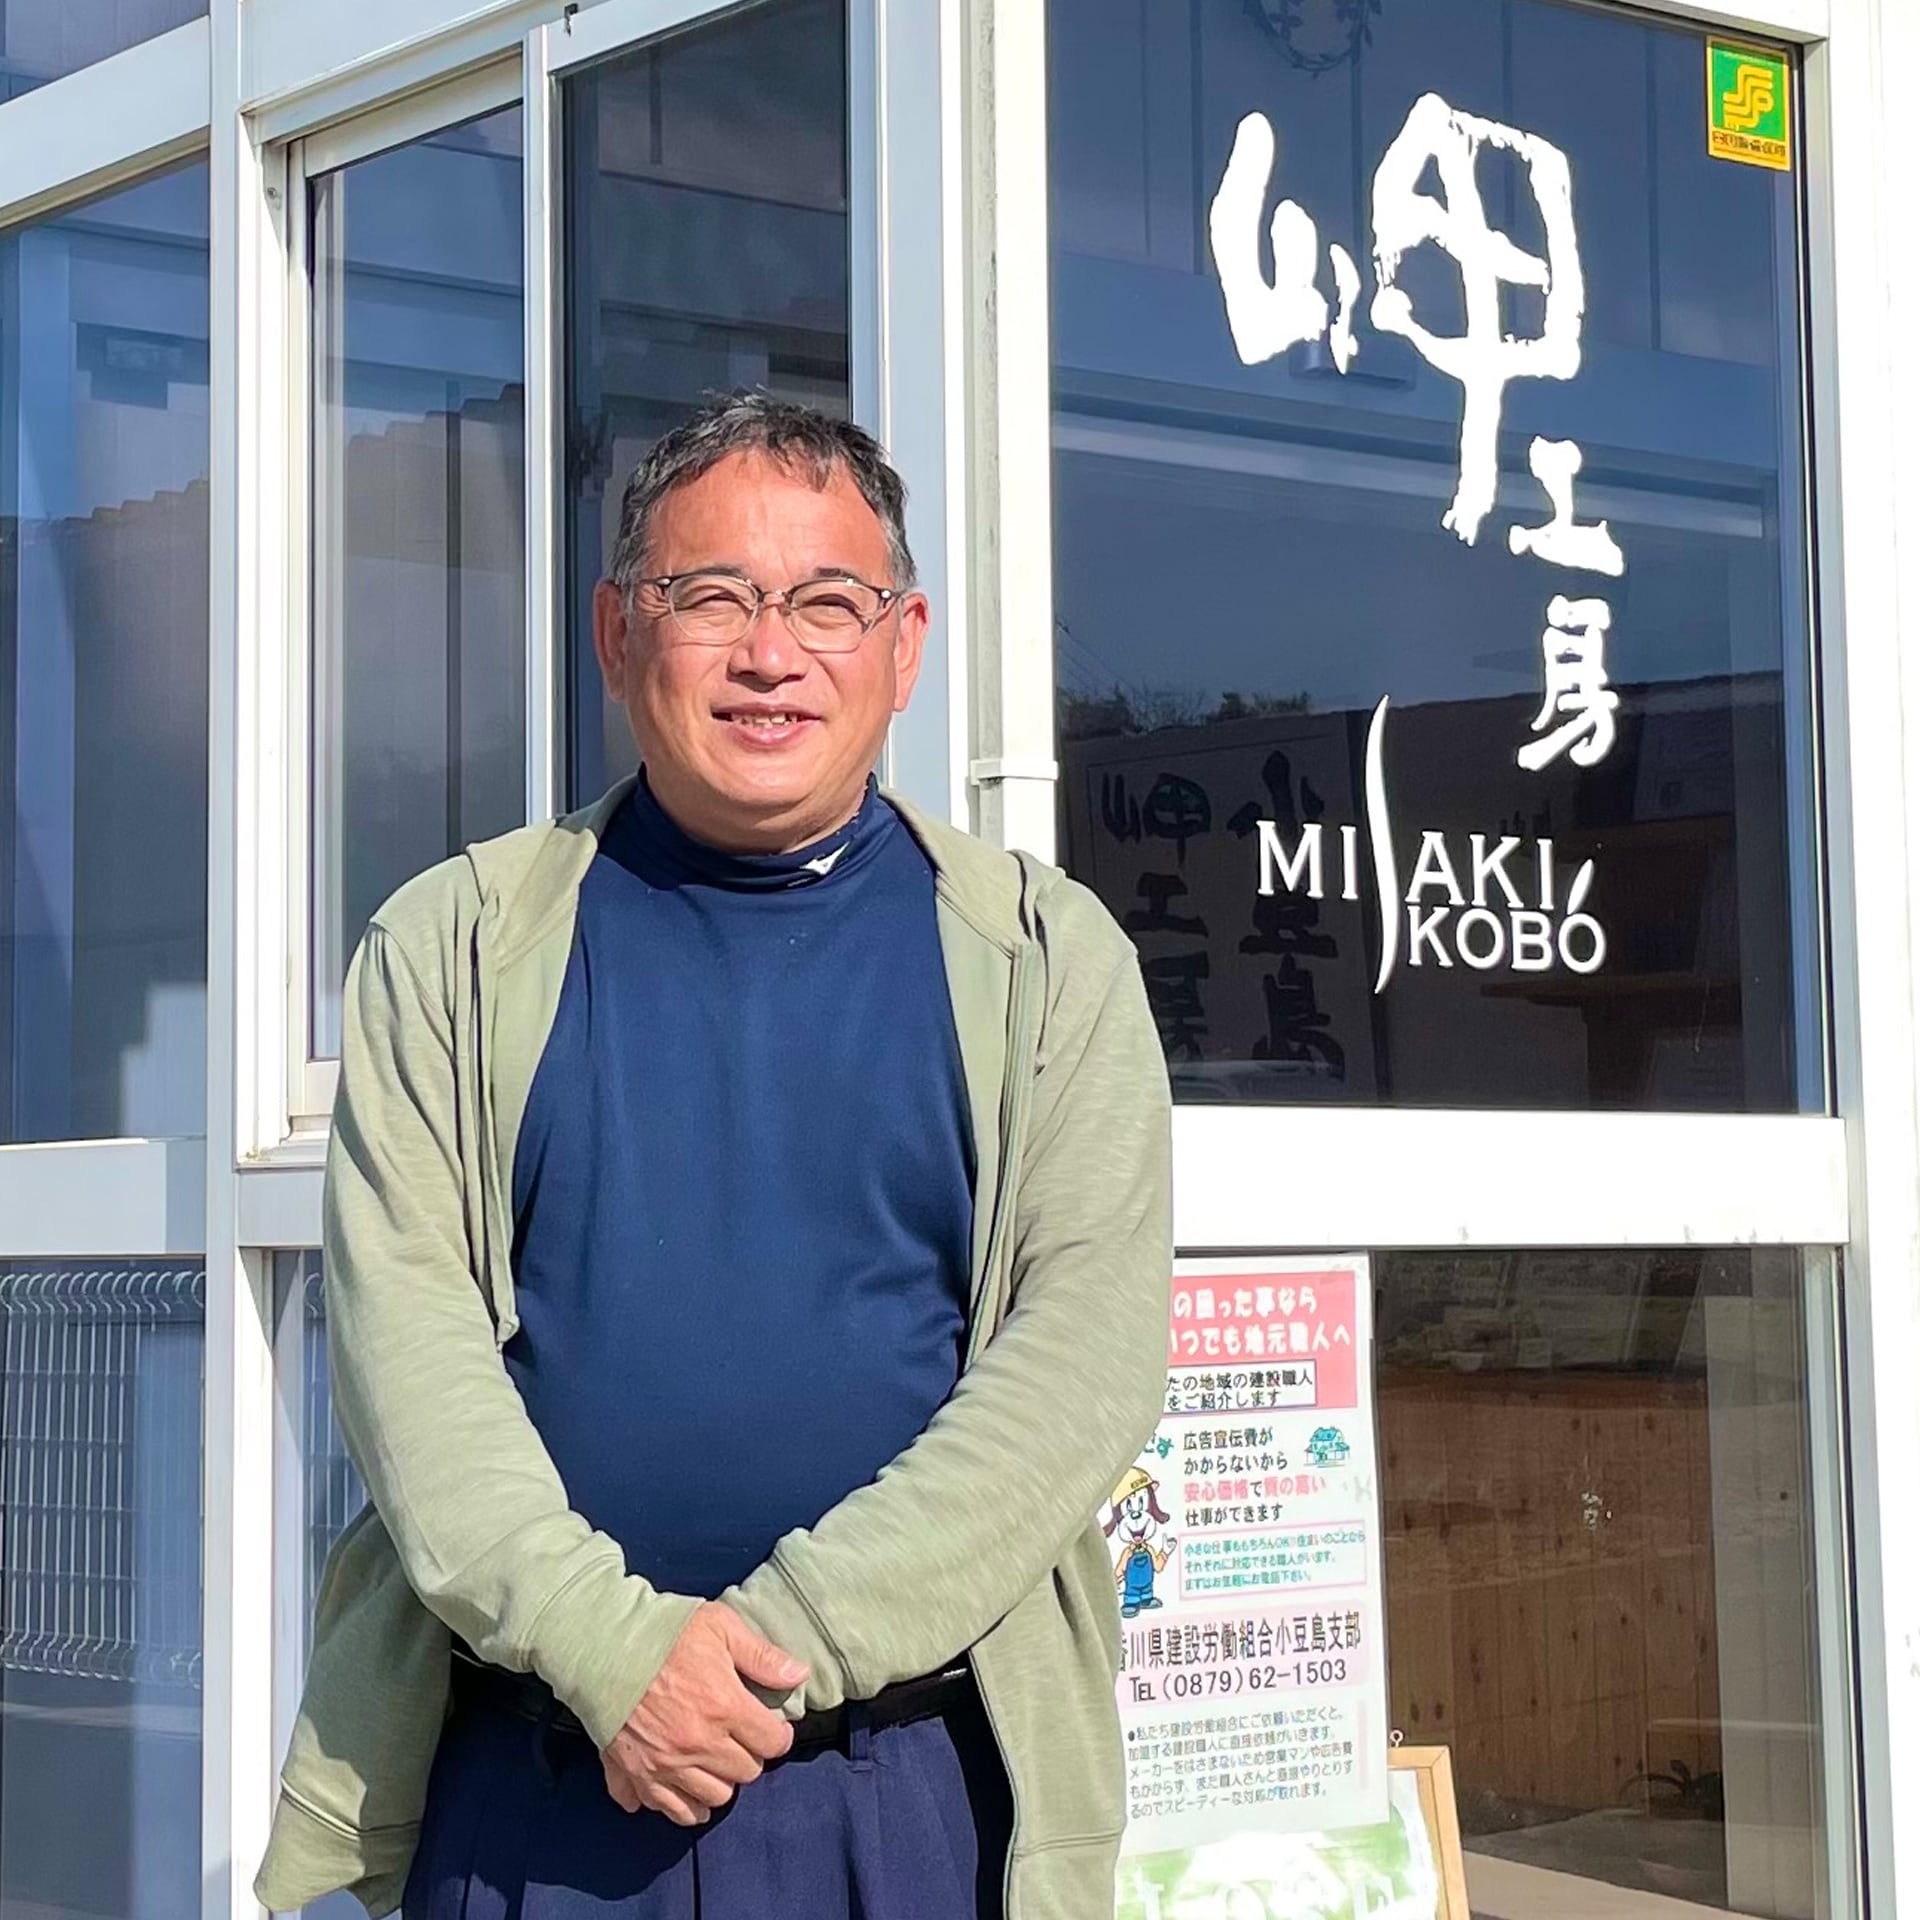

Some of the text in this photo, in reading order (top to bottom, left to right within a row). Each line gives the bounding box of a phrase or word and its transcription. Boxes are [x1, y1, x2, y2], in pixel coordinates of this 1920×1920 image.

[1256, 694, 1554, 993] MISAKI
[1183, 1425, 1274, 1451] 広告宣伝費が
[1184, 1451, 1289, 1476] かからないから
[1184, 1474, 1327, 1503] 安心価格で質の高い
[1185, 1503, 1284, 1527] 仕事ができます
